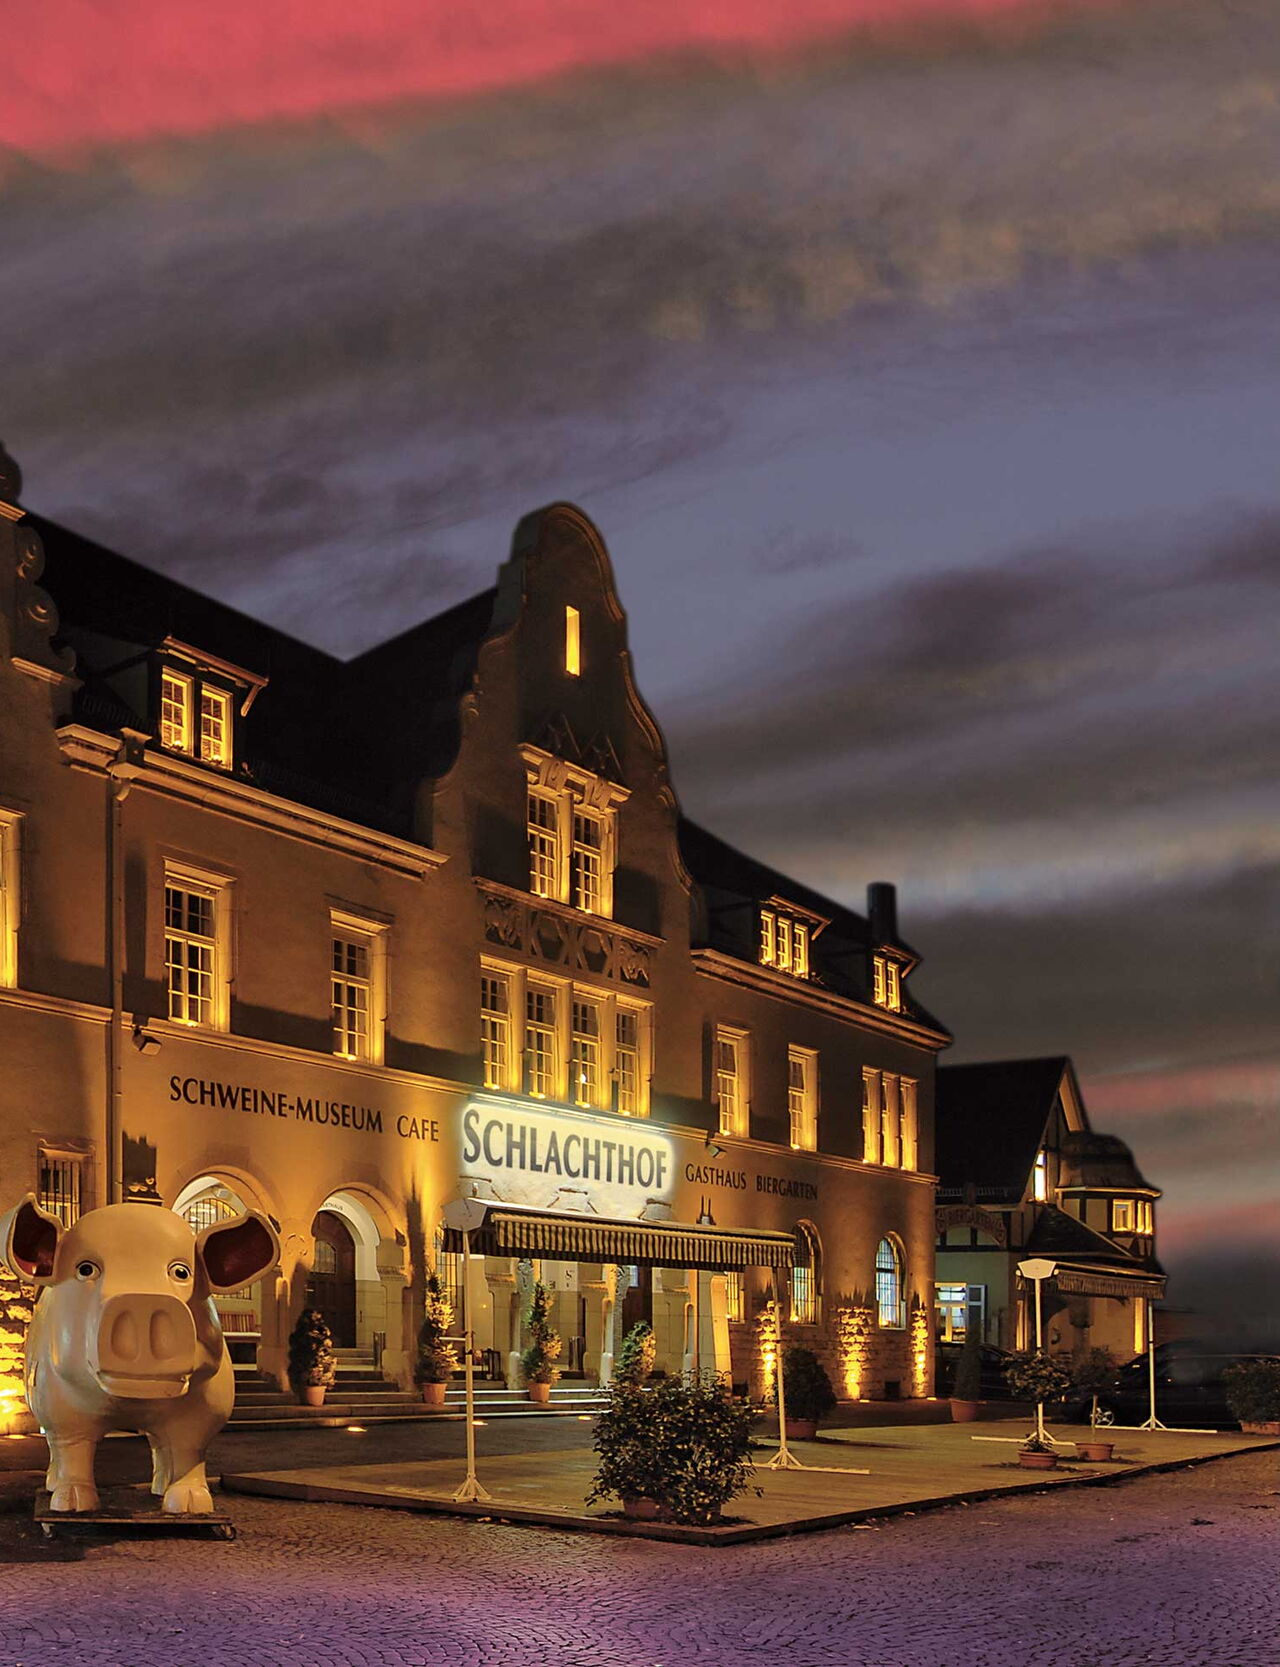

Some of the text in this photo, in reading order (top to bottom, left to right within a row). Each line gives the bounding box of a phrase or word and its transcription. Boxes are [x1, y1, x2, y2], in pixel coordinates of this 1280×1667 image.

[170, 1075, 440, 1142] SCHWEINE-MUSEUM CAFE
[463, 1108, 667, 1188] SCHLACHTHOF
[685, 1163, 818, 1200] GASTHAUS BIERGARTEN
